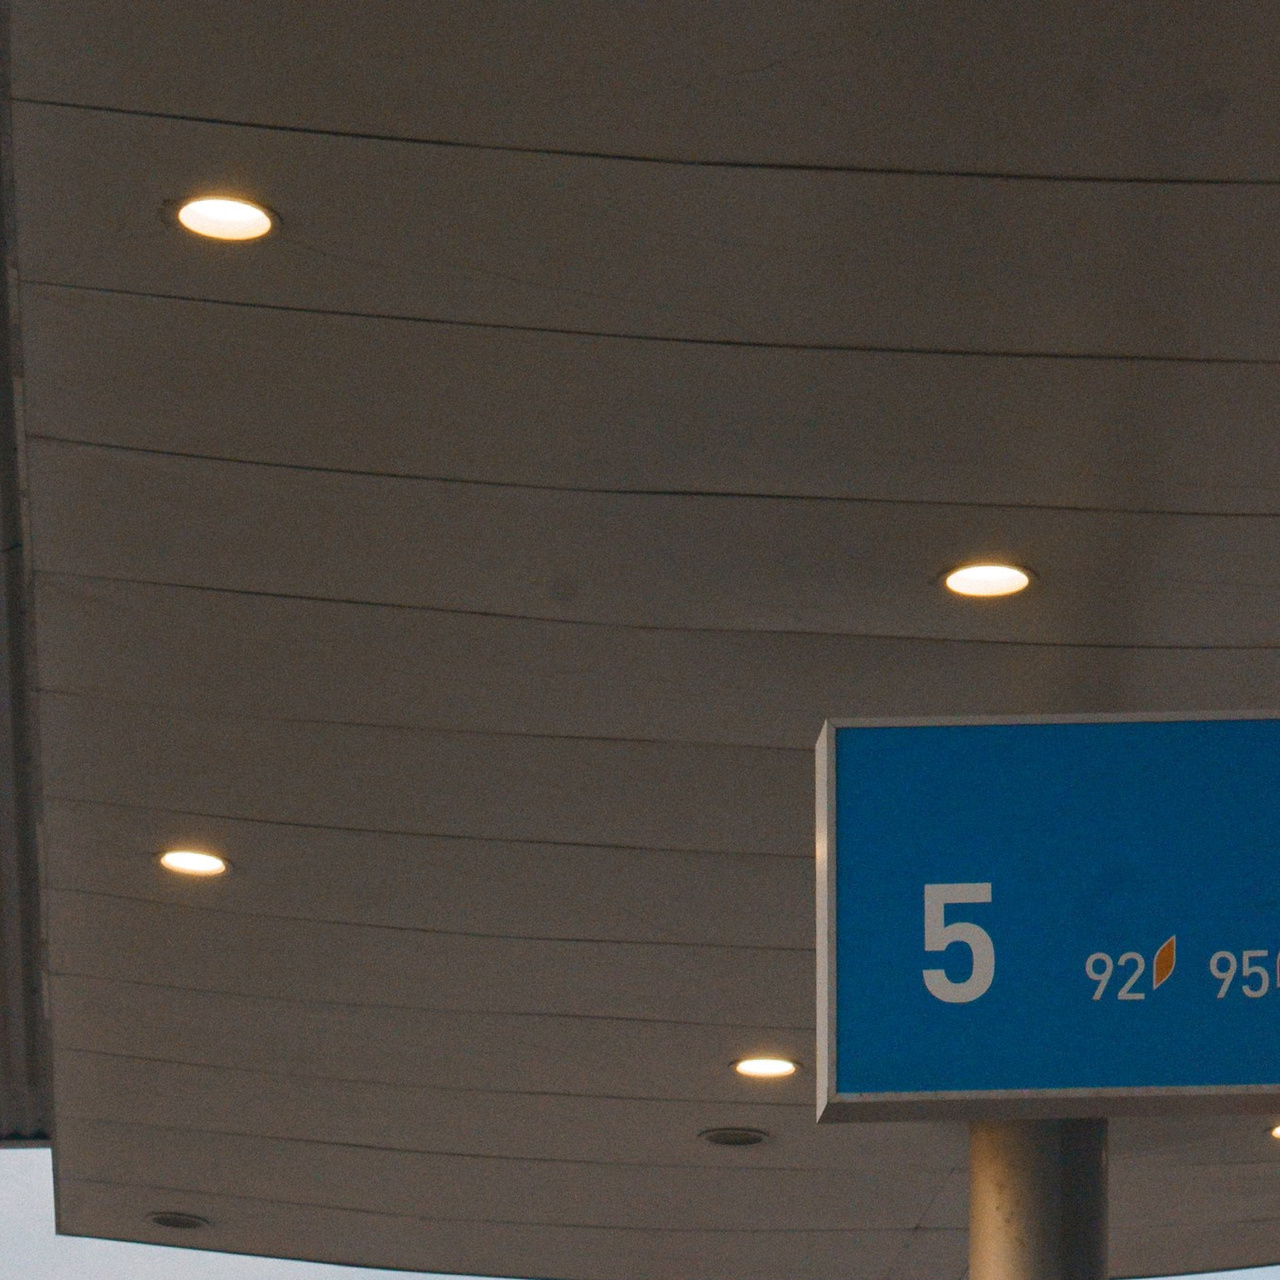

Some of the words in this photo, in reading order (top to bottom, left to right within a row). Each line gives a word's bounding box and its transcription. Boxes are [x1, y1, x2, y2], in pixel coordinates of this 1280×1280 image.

[922, 882, 996, 1004] 5
[1085, 951, 1146, 1001] 92
[1209, 949, 1270, 999] 95
